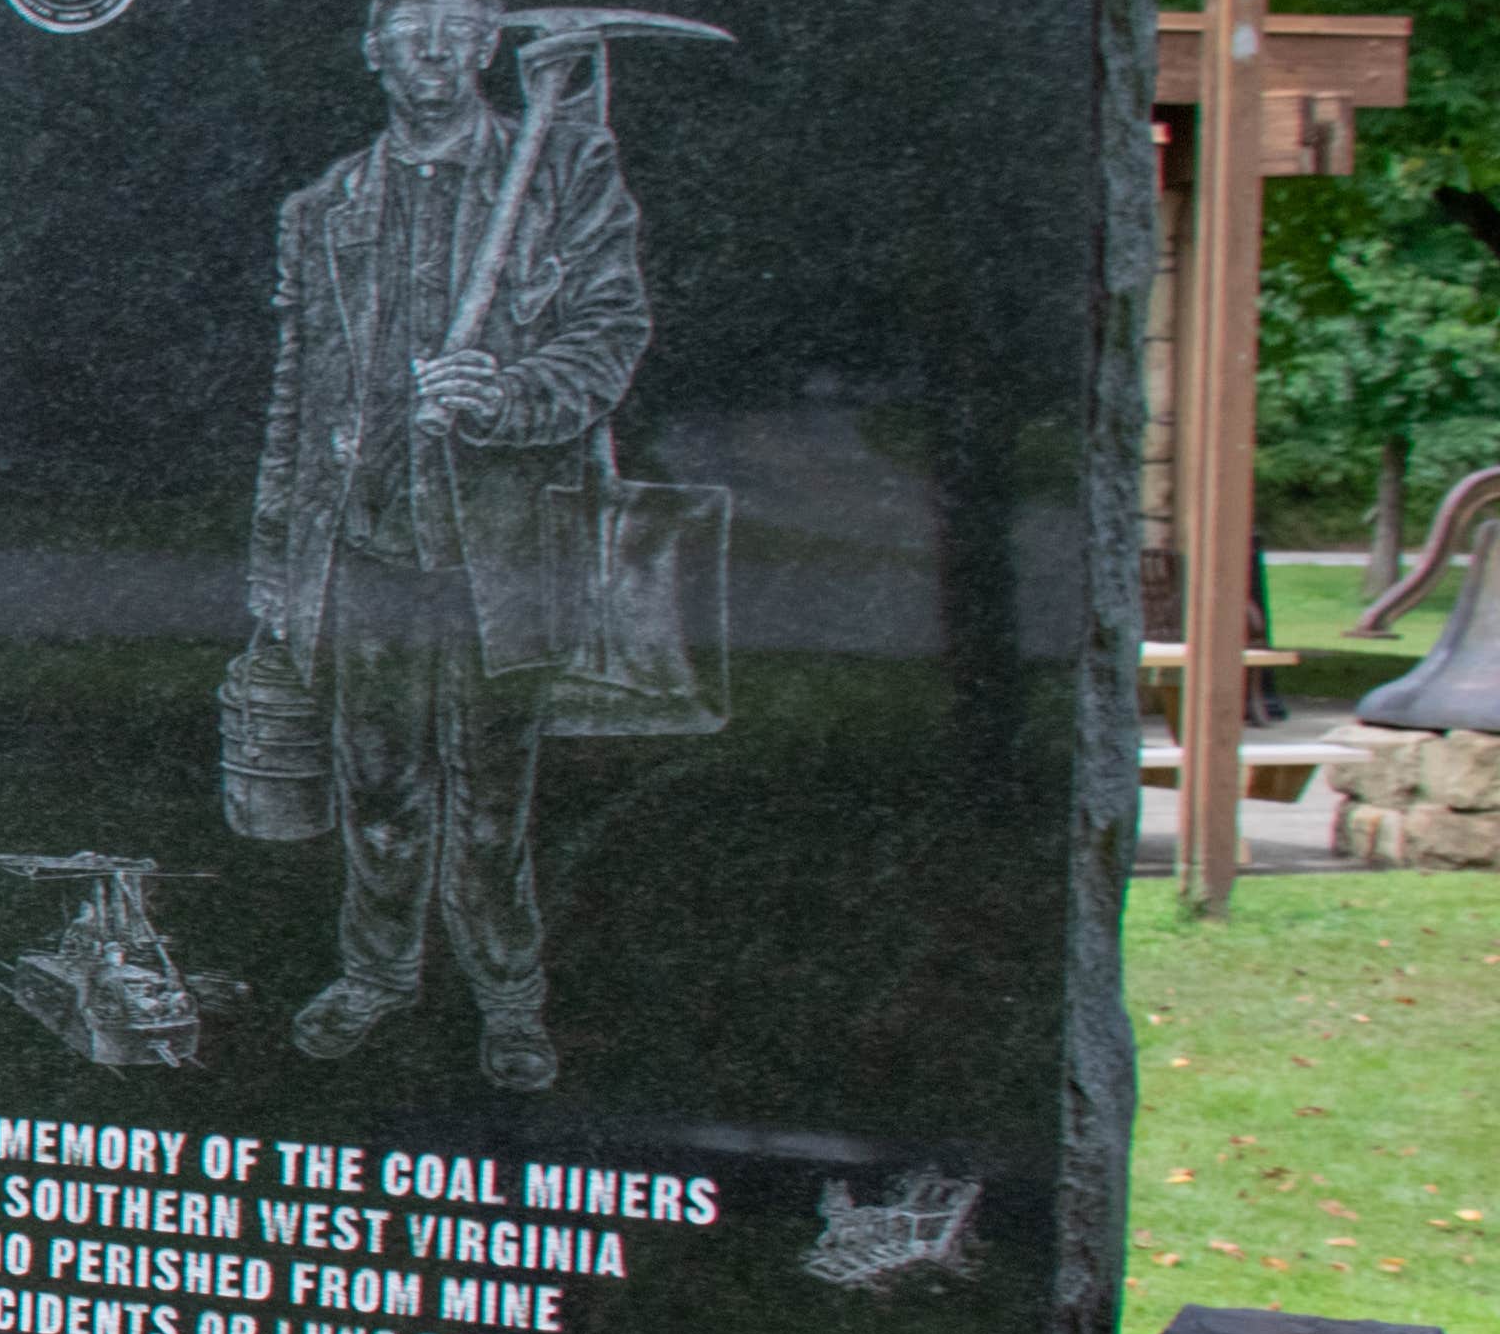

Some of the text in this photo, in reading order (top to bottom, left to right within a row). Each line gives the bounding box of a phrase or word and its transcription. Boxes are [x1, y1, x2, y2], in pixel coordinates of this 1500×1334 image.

[4, 1175, 239, 1238] SOUTHERN
[260, 1200, 389, 1253] WEST
[410, 1215, 624, 1277] VIRGINIA
[203, 1136, 259, 1181] OF
[277, 1142, 362, 1191] THE
[384, 1152, 504, 1203] COAL
[526, 1164, 716, 1224] MINERS
[51, 1239, 272, 1300] PERISHED
[292, 1263, 420, 1315] FROM
[442, 1278, 561, 1331] MINE
